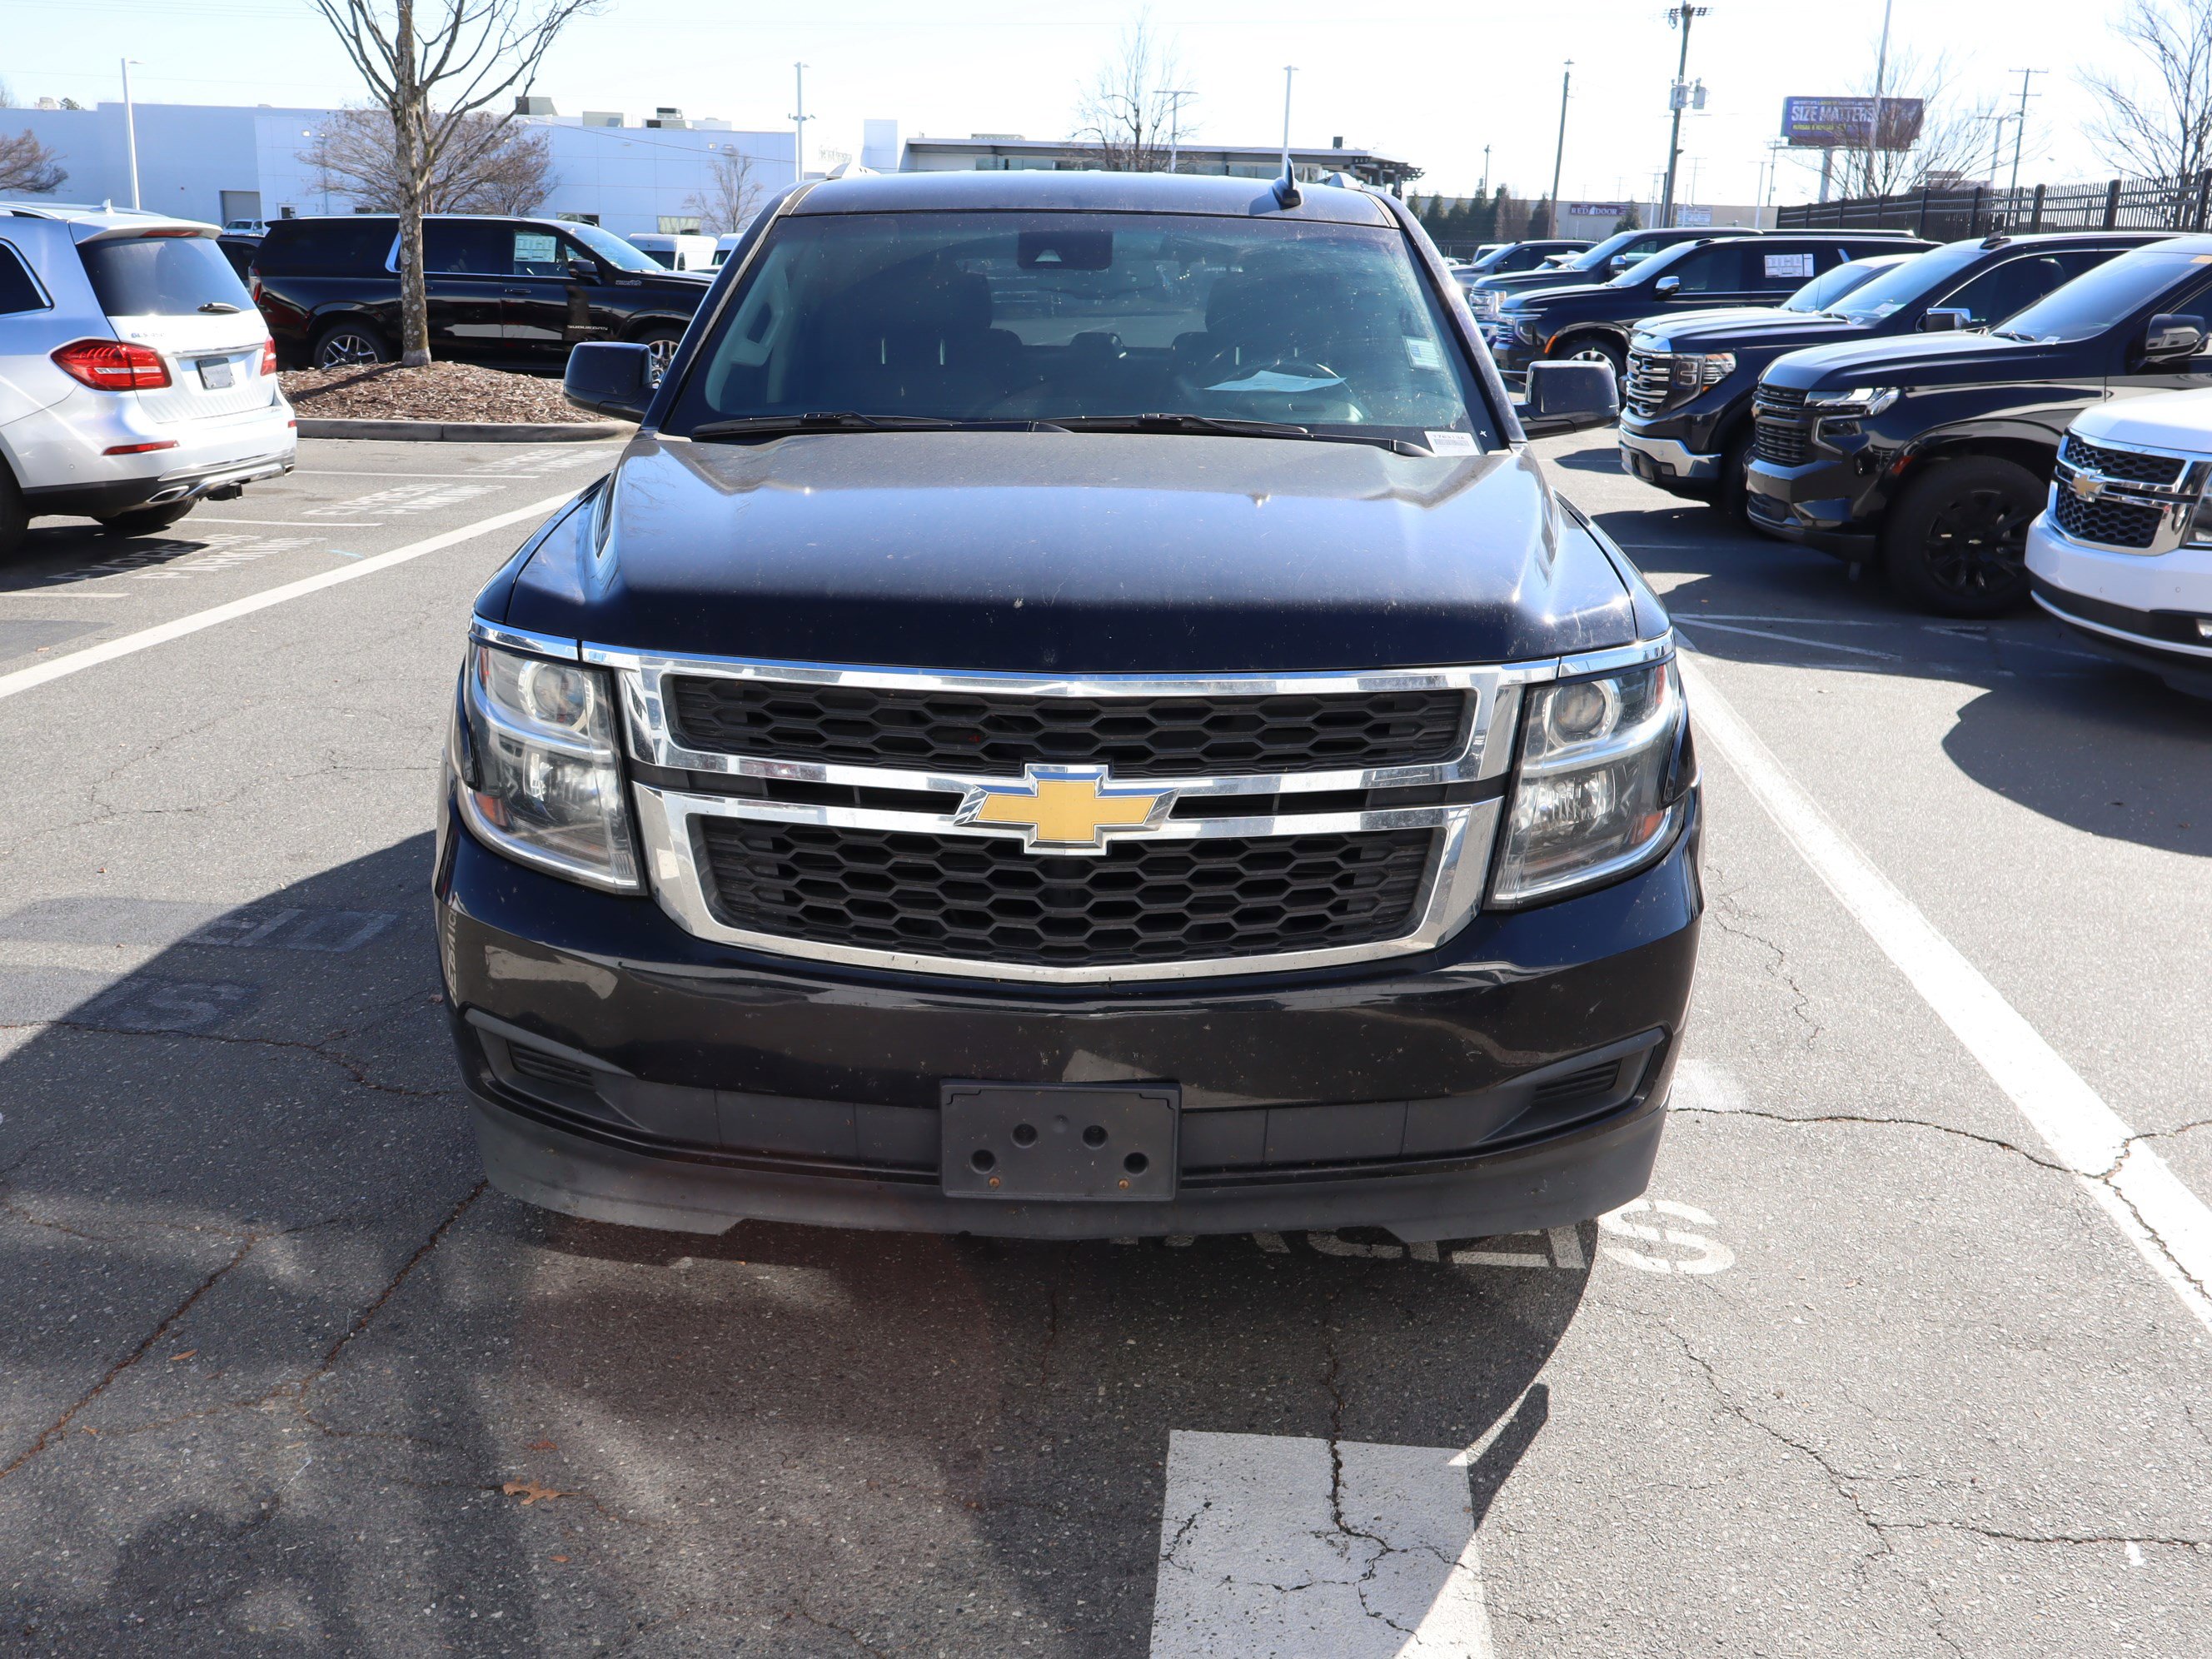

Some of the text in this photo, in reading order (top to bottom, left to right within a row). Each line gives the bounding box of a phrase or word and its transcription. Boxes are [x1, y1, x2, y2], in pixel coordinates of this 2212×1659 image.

[1791, 106, 1877, 122] SIZE MATTERS
[301, 483, 453, 516] EXPRESS
[369, 485, 506, 515] PARKING
[132, 537, 328, 580] PARKING
